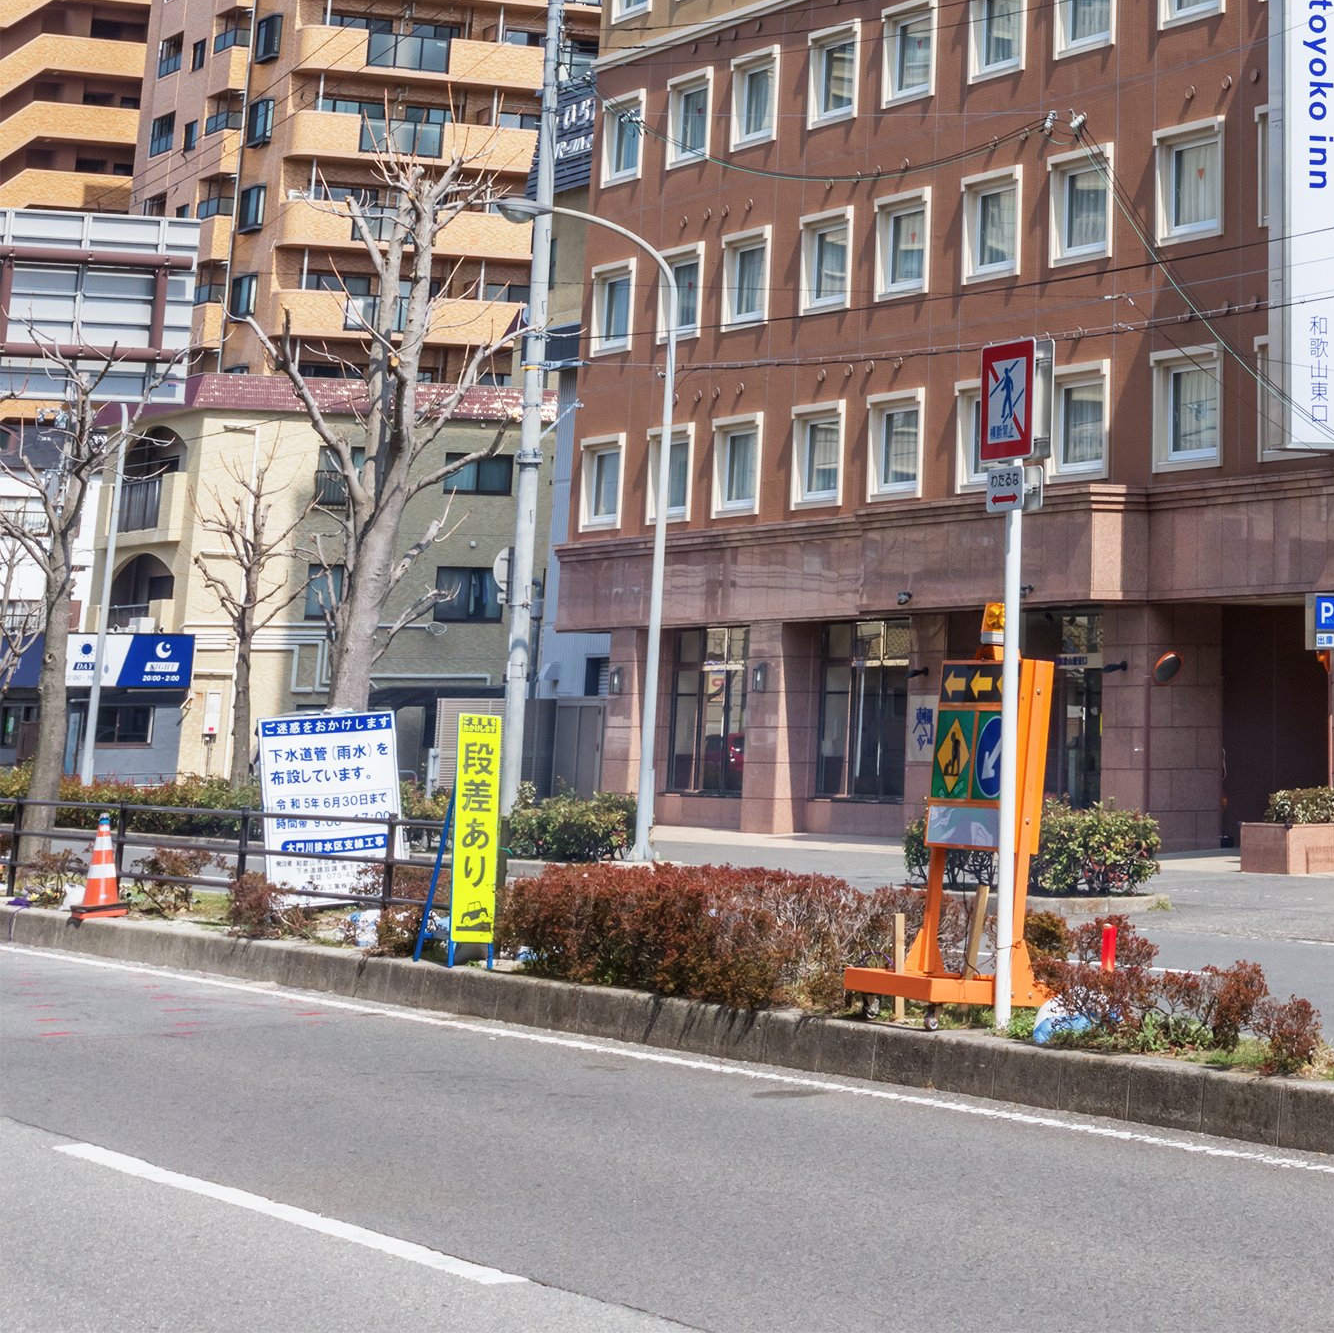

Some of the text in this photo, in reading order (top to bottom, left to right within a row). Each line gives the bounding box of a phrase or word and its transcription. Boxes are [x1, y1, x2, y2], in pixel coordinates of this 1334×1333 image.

[1308, 135, 1334, 190] inn
[1308, 315, 1329, 423] 和歌山東口
[990, 424, 1014, 440] 横断禁止
[990, 472, 1019, 488] わたるな
[1321, 602, 1334, 624] P
[264, 716, 390, 734] ご迷惑をおかけします
[270, 766, 372, 786] 布設しています。
[462, 741, 494, 888] 段差あり
[286, 835, 385, 853] 大門川排水区支線工事
